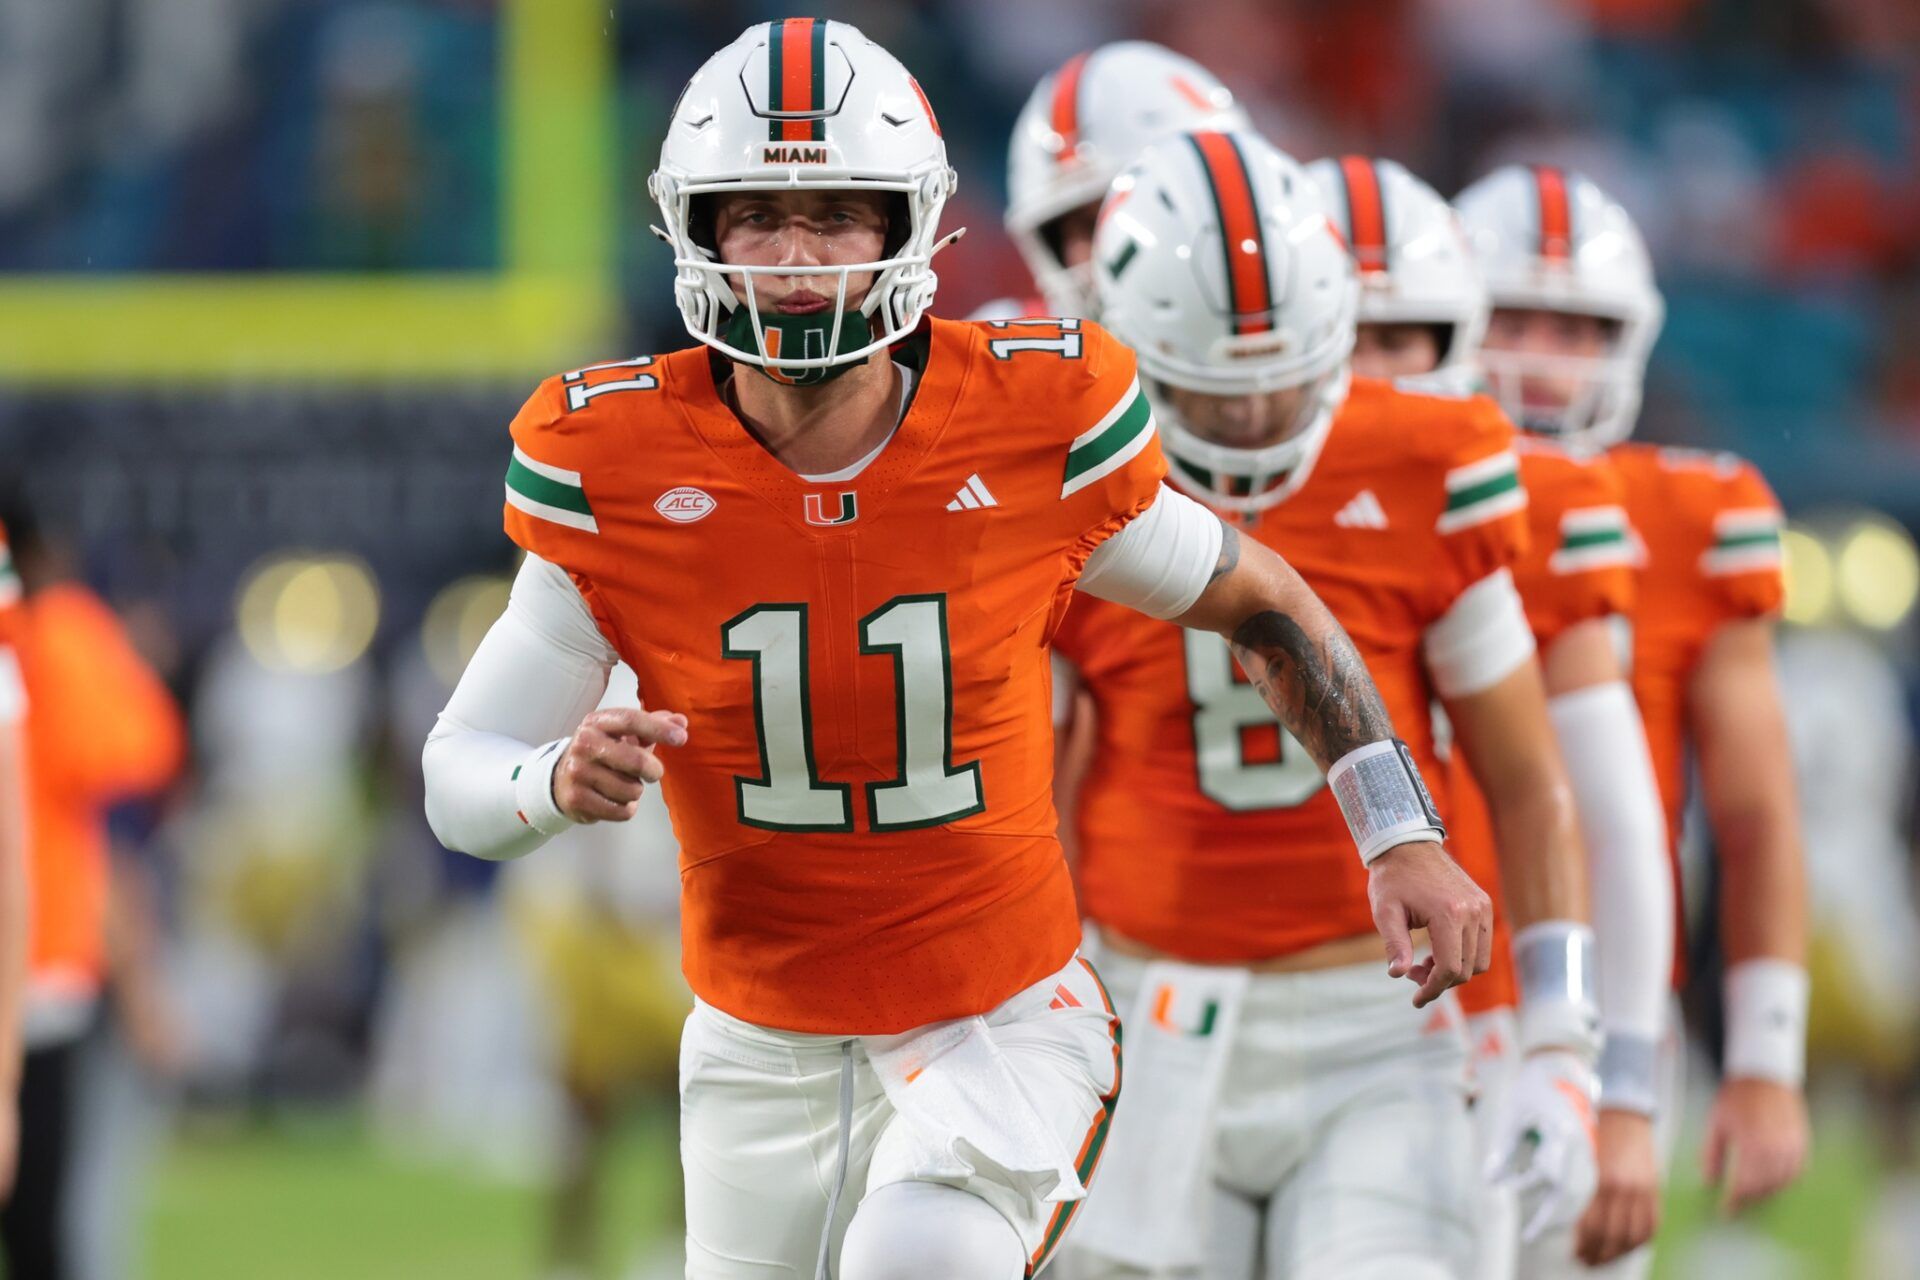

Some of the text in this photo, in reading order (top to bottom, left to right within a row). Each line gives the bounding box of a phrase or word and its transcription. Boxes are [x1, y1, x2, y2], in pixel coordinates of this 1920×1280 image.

[763, 148, 827, 164] MIAMI
[763, 326, 826, 386] U
[664, 496, 706, 510] ACC
[803, 490, 859, 526] U
[720, 592, 987, 833] 11
